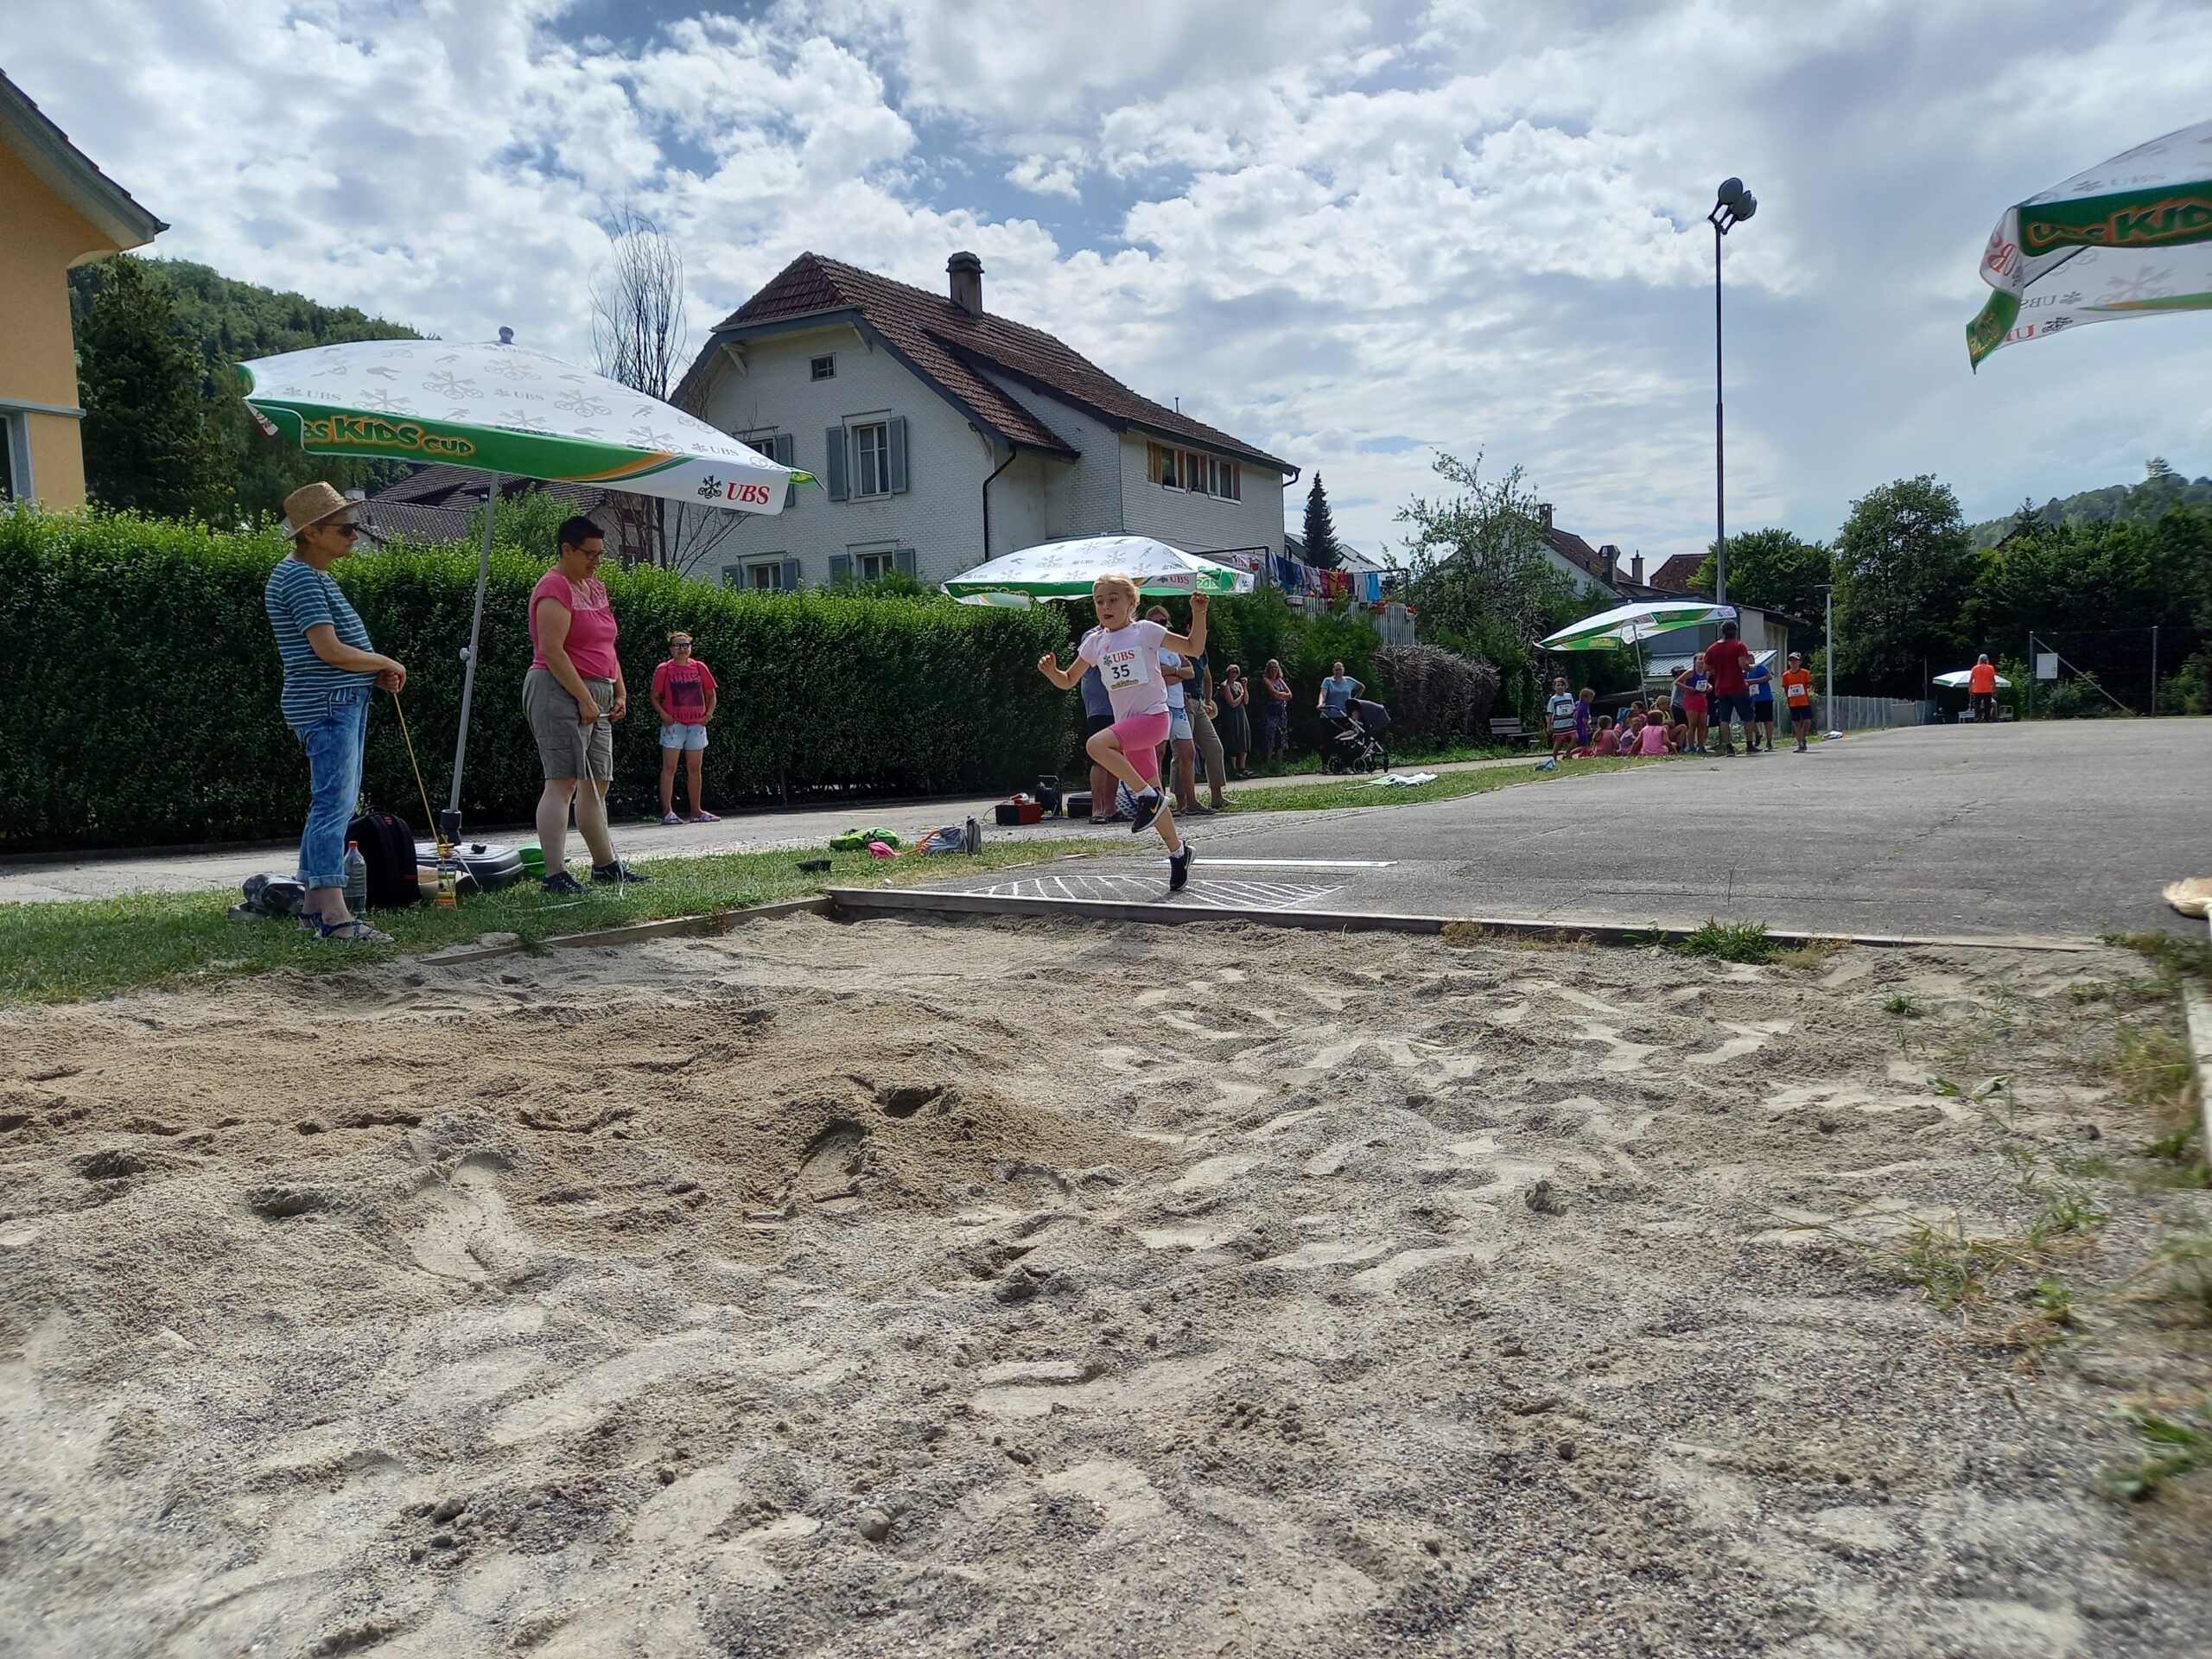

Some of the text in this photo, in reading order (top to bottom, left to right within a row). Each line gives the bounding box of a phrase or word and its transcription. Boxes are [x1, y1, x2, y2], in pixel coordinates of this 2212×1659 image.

[307, 391, 340, 402] UBS
[514, 391, 544, 401] UBS
[331, 416, 423, 448] KIDS
[709, 446, 740, 457] UBS
[727, 481, 772, 505] UBS
[1169, 575, 1190, 585] UBS
[1113, 649, 1135, 663] UBS
[1111, 664, 1130, 680] 35
